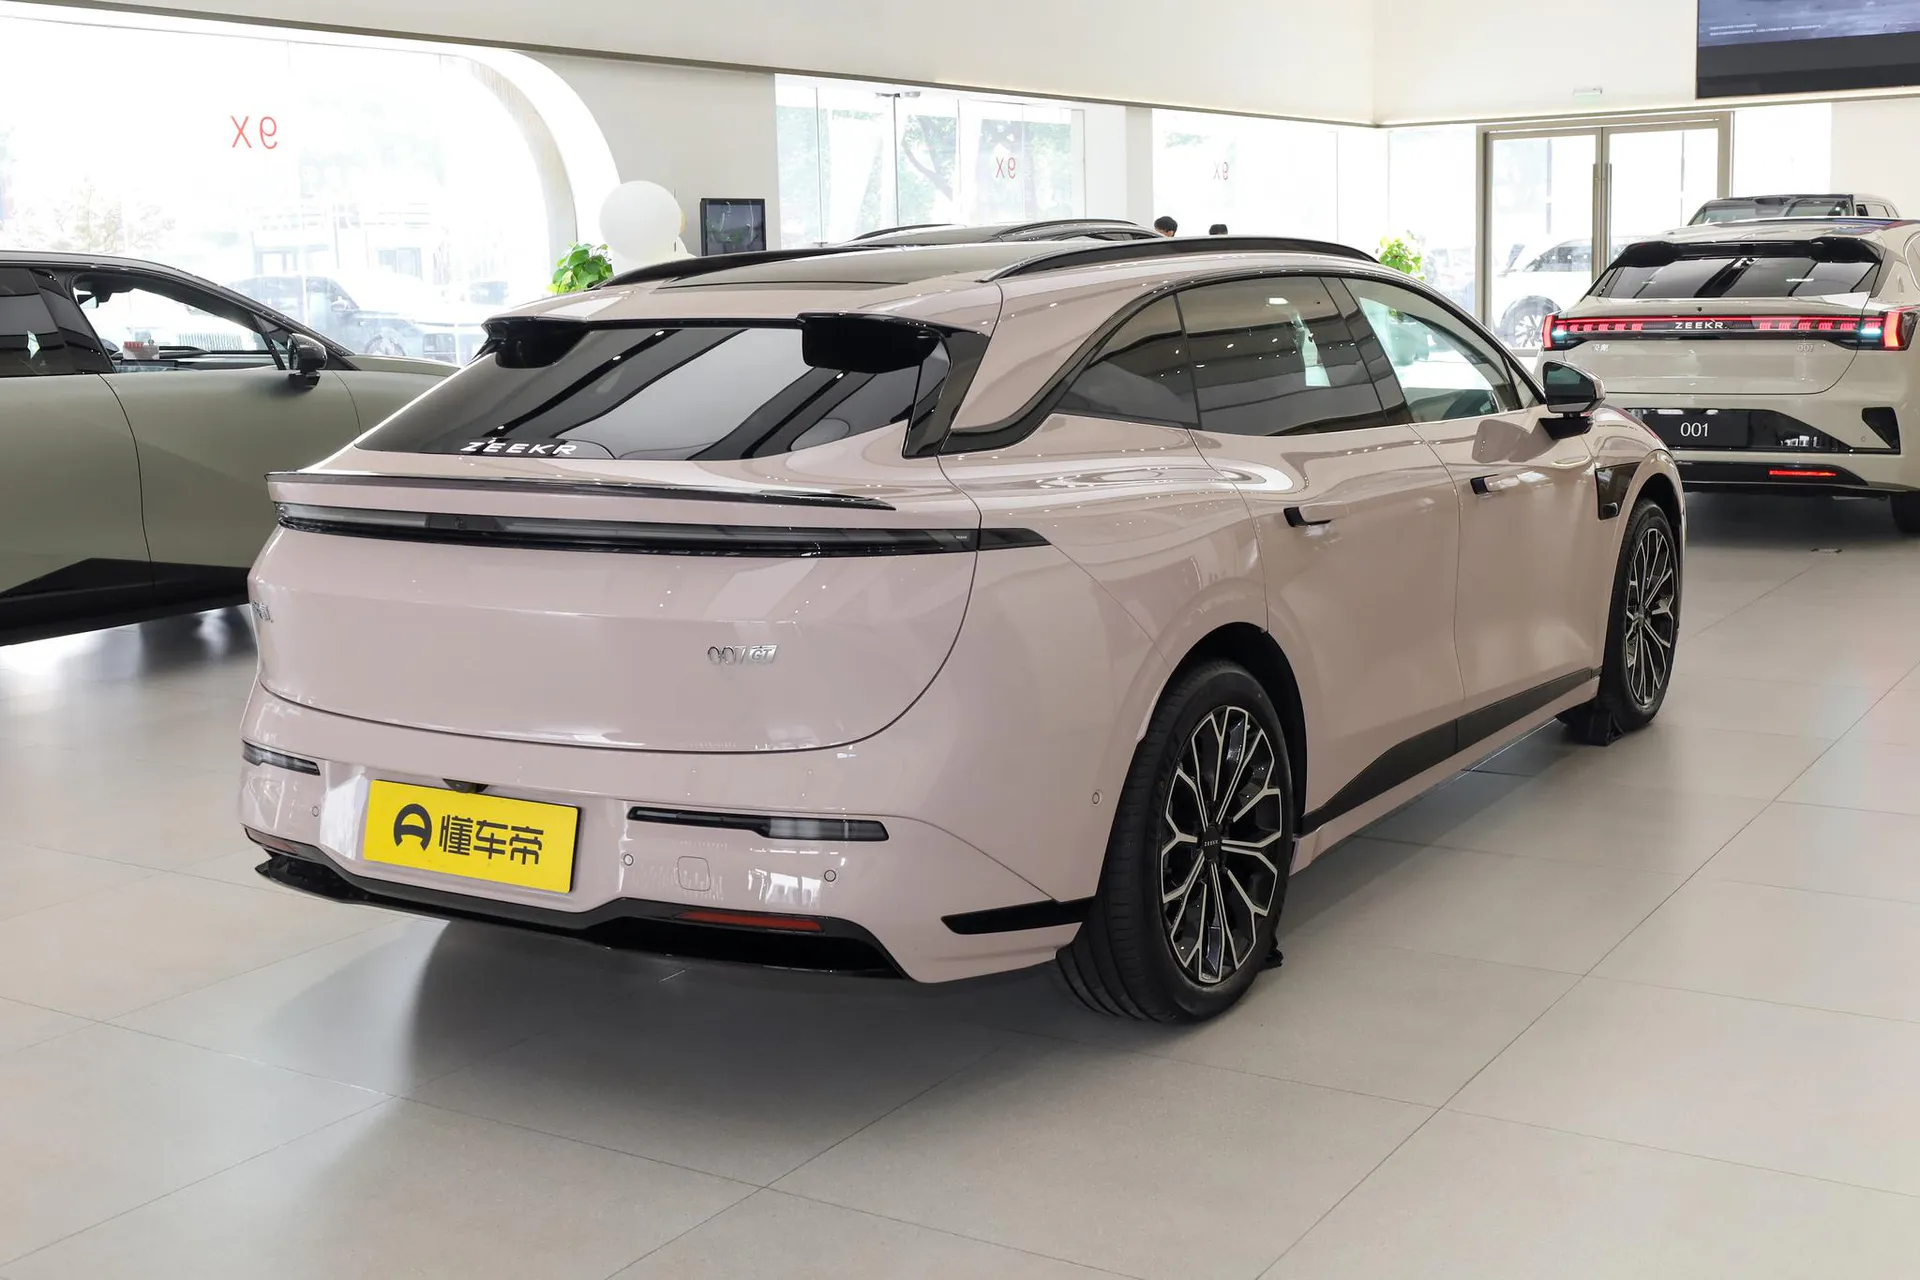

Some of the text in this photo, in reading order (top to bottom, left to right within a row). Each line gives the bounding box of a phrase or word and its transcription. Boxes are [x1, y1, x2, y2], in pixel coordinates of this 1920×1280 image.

[1674, 321, 1724, 329] ZEEKR
[1680, 422, 1708, 437] 001
[460, 442, 577, 455] ZEEKR
[438, 814, 544, 865] 懂车帝
